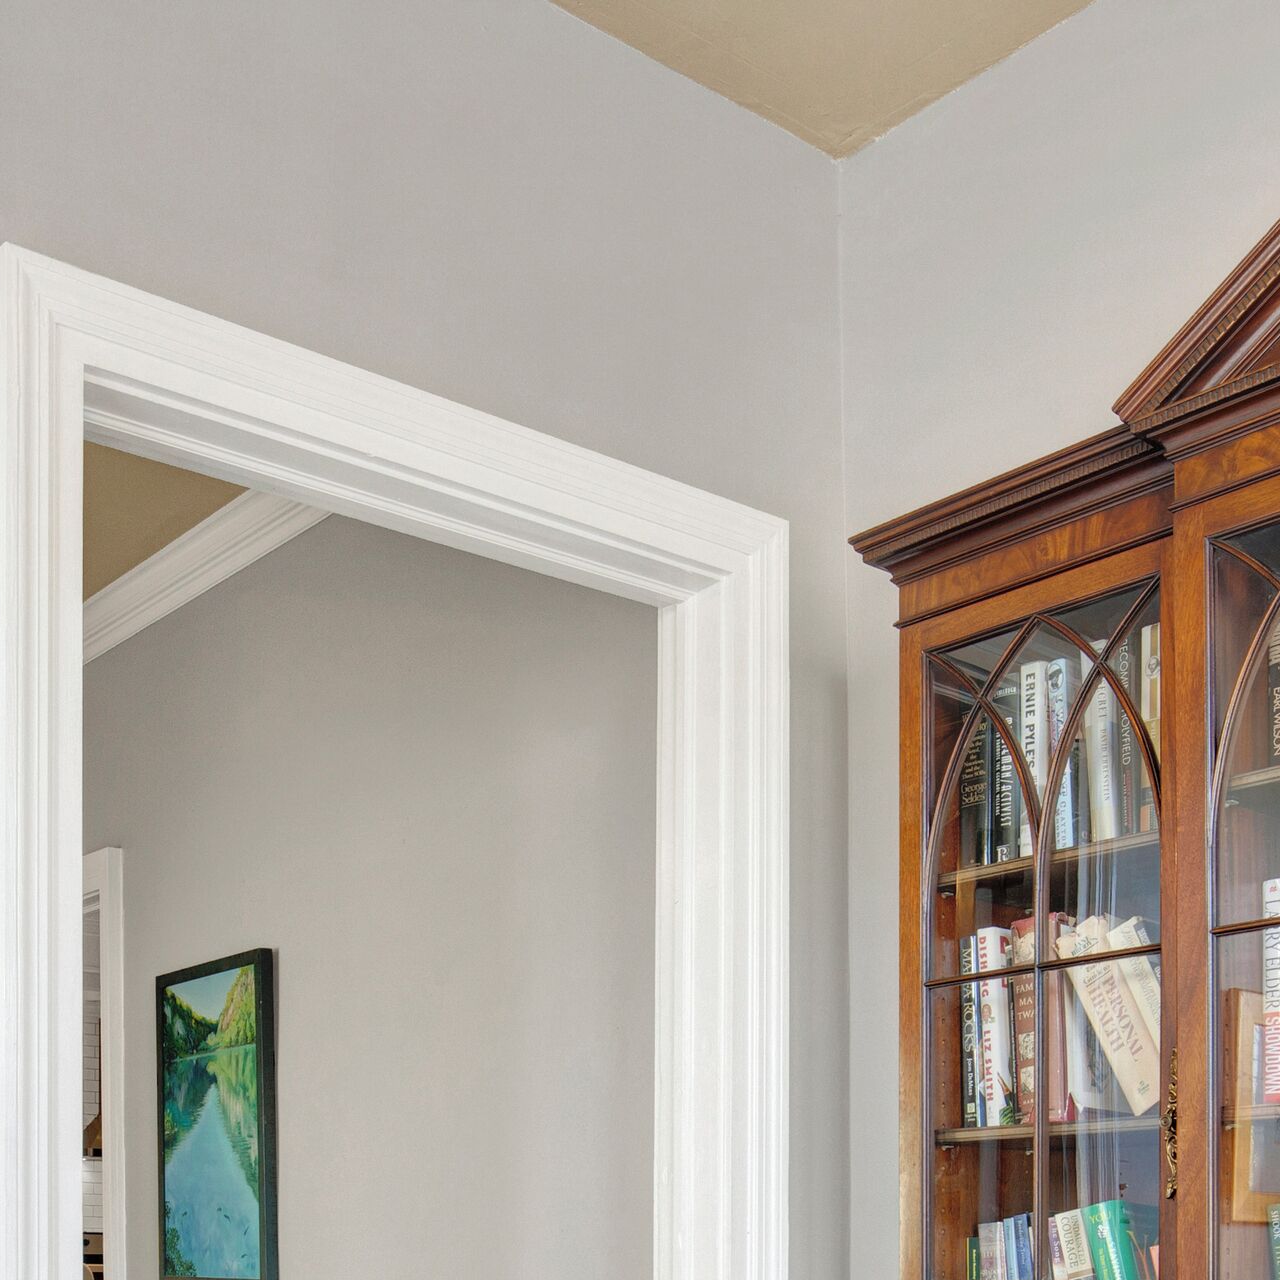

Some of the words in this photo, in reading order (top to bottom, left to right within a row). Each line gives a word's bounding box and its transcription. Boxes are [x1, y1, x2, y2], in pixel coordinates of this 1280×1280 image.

[1025, 672, 1036, 719] ERNIE
[1024, 723, 1035, 769] PYLE'S
[1265, 899, 1280, 949] LARY
[978, 935, 990, 998] DISHNG
[1265, 957, 1280, 1011] ELDER
[963, 1006, 975, 1053] ROCKS
[983, 1029, 991, 1052] LIZ
[1088, 984, 1126, 1055] HEALTH
[1103, 972, 1144, 1062] PERSONAL
[985, 1058, 995, 1102] SMITH
[1060, 1215, 1079, 1269] COURAGE
[1070, 1213, 1087, 1265] UNDAUNTED
[1089, 1213, 1111, 1225] YOU
[1271, 1210, 1280, 1240] SHOOK
[1053, 1235, 1061, 1264] Song
